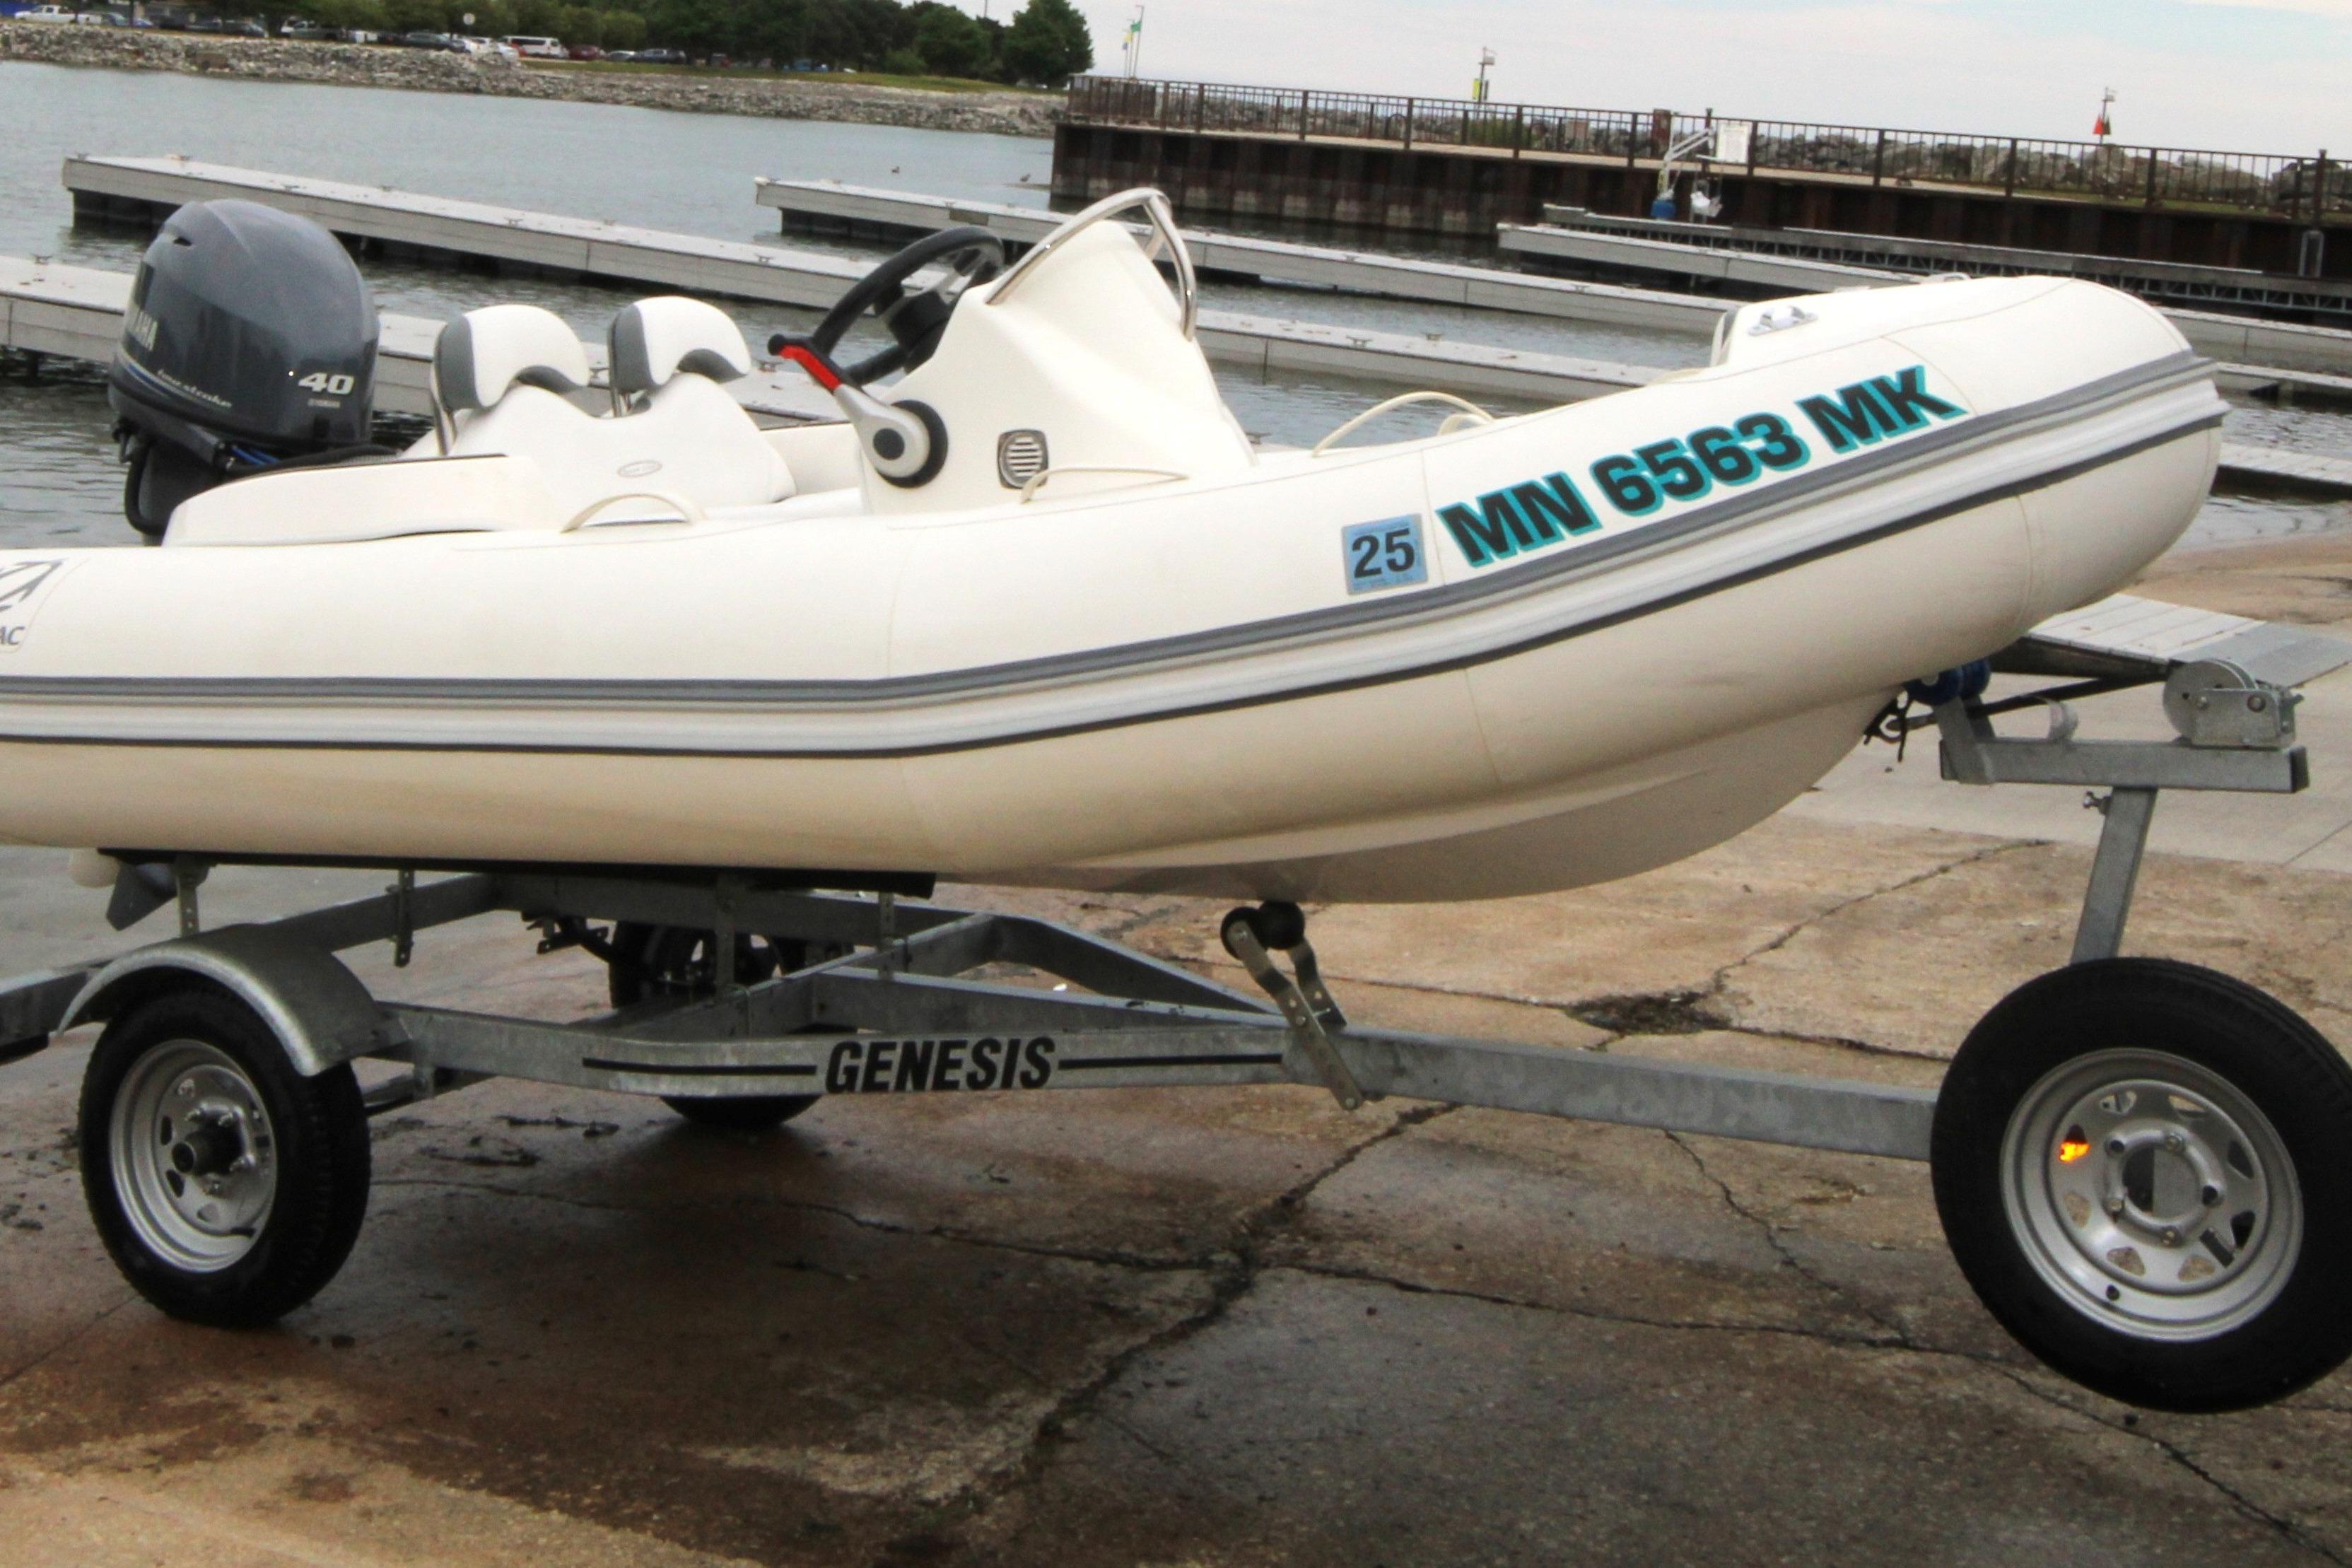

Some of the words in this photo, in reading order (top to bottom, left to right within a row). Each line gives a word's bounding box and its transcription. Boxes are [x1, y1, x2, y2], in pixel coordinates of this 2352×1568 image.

[298, 372, 354, 394] 40
[1435, 471, 1603, 568] MN
[1590, 412, 1811, 517] 6563
[1795, 365, 1969, 454] MK
[1352, 527, 1415, 578] 25
[825, 1036, 1055, 1093] GENESIS
